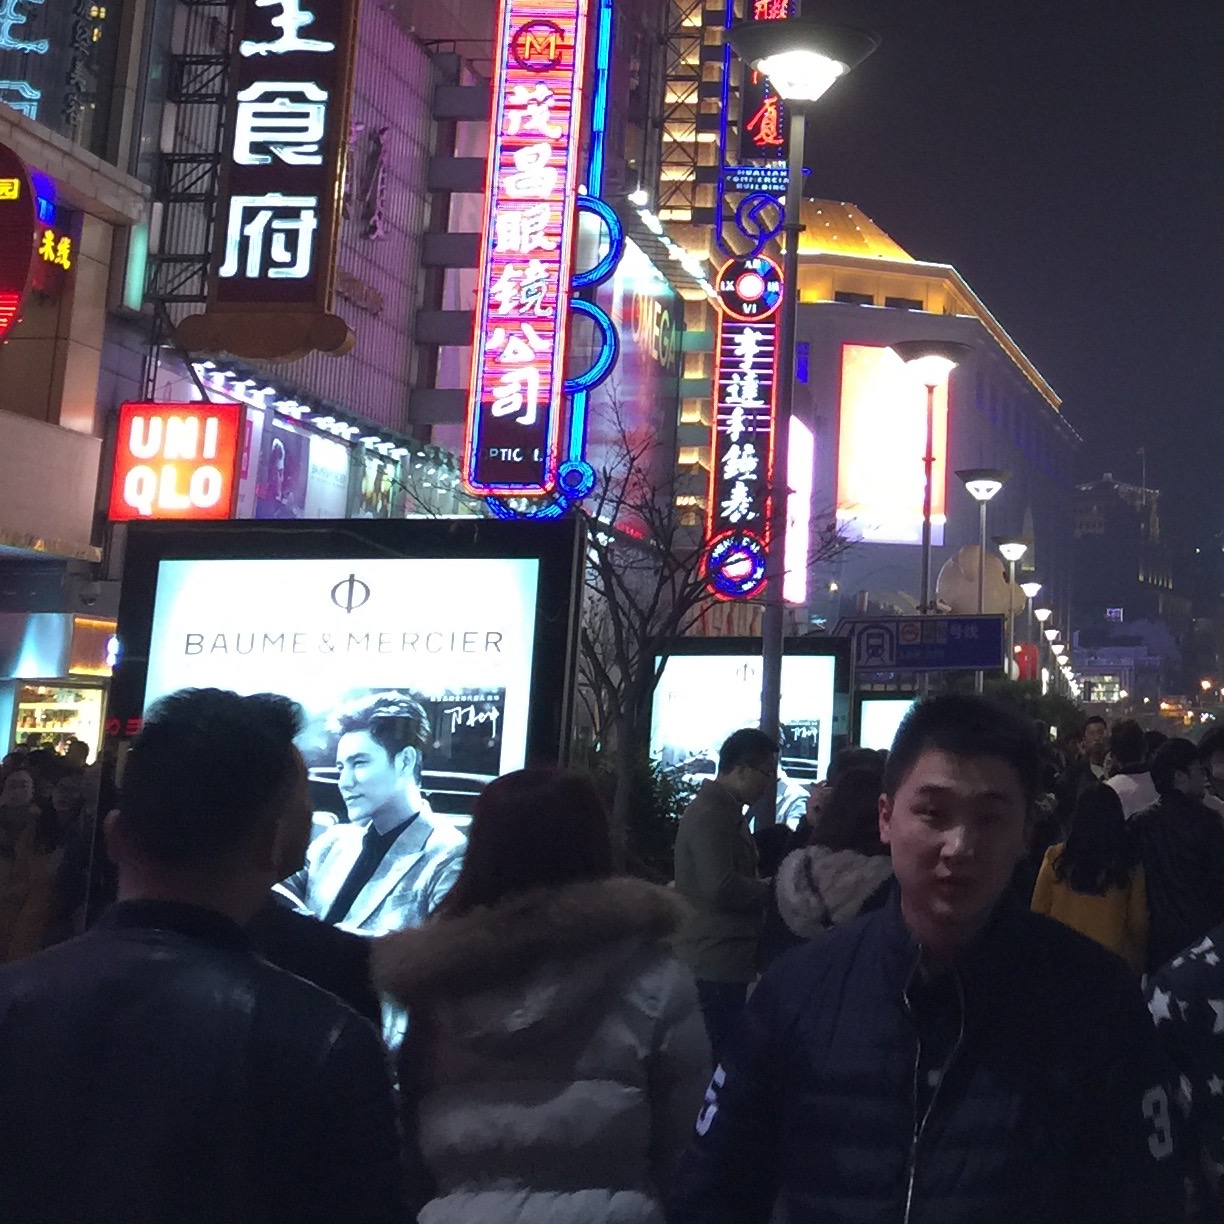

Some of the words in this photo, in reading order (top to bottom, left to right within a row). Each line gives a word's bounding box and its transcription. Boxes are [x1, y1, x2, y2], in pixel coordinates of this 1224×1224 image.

[129, 415, 219, 460] UNI
[124, 465, 223, 516] QLO
[184, 633, 308, 655] BAUME
[347, 631, 504, 654] MERCIER
